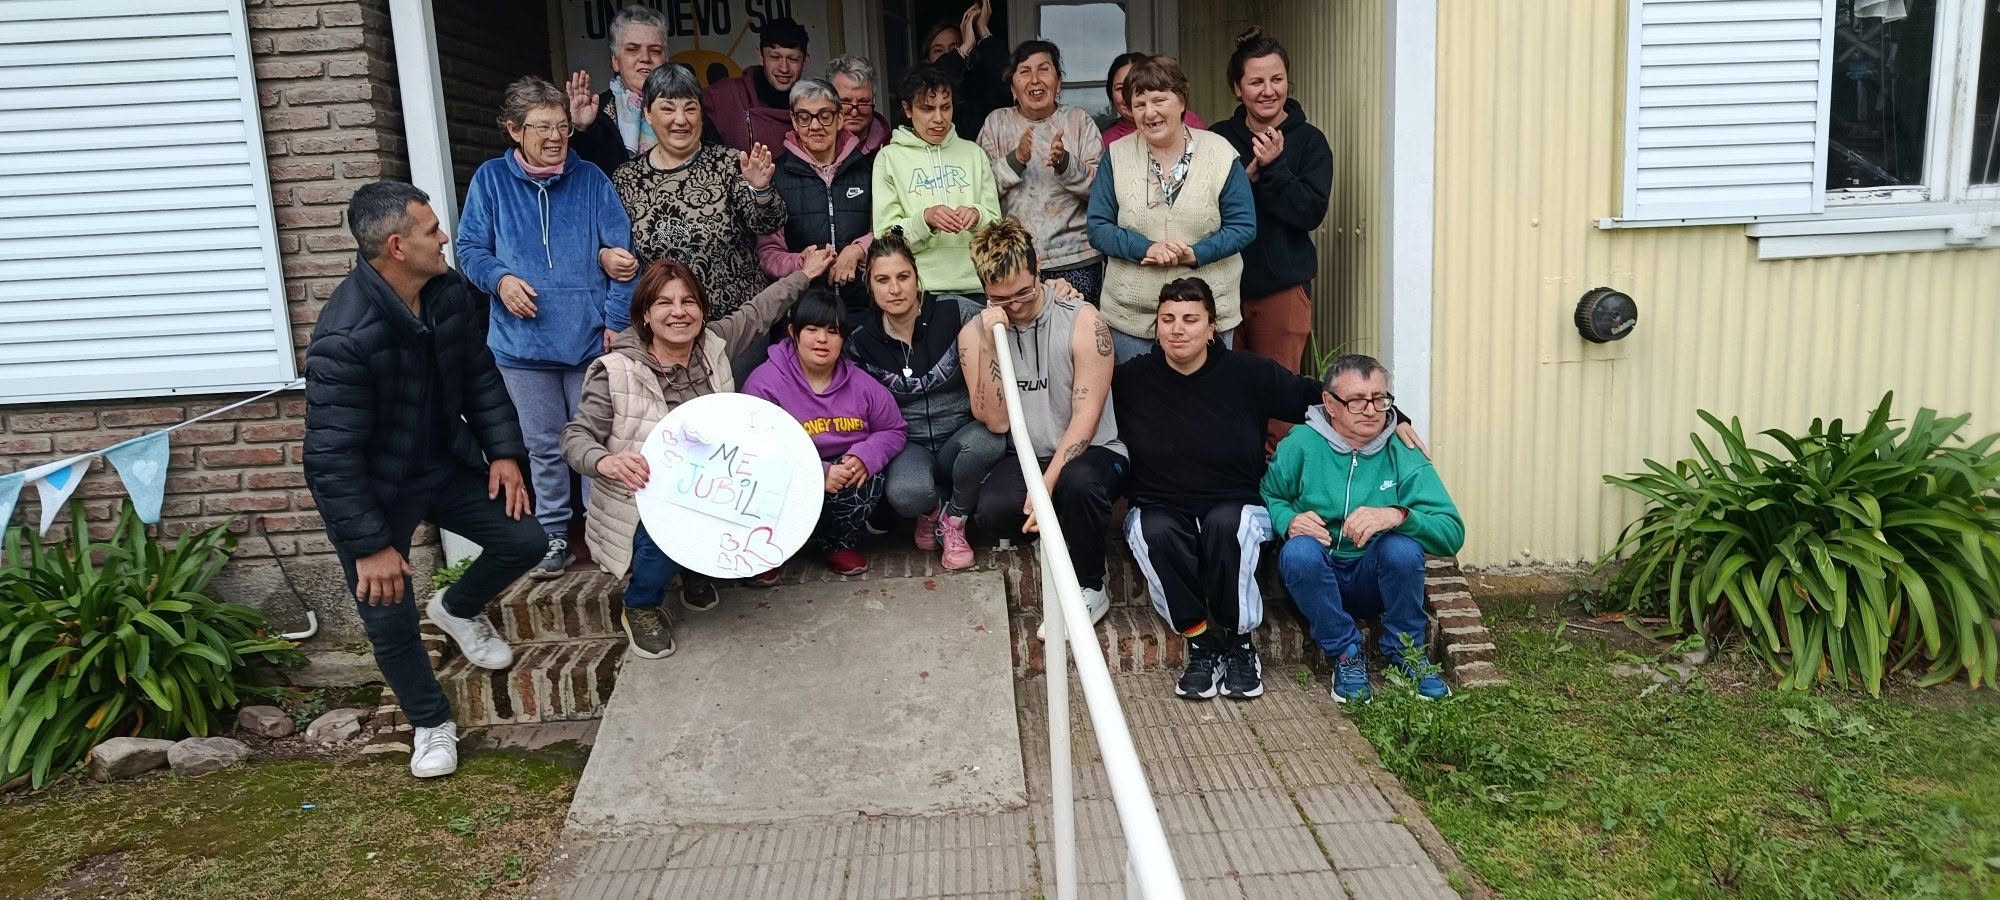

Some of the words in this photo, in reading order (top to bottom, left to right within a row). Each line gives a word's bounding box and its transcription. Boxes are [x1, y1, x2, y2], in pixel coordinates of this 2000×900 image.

[908, 165, 971, 193] AIR
[1016, 377, 1048, 391] RUN
[708, 443, 758, 477] ME
